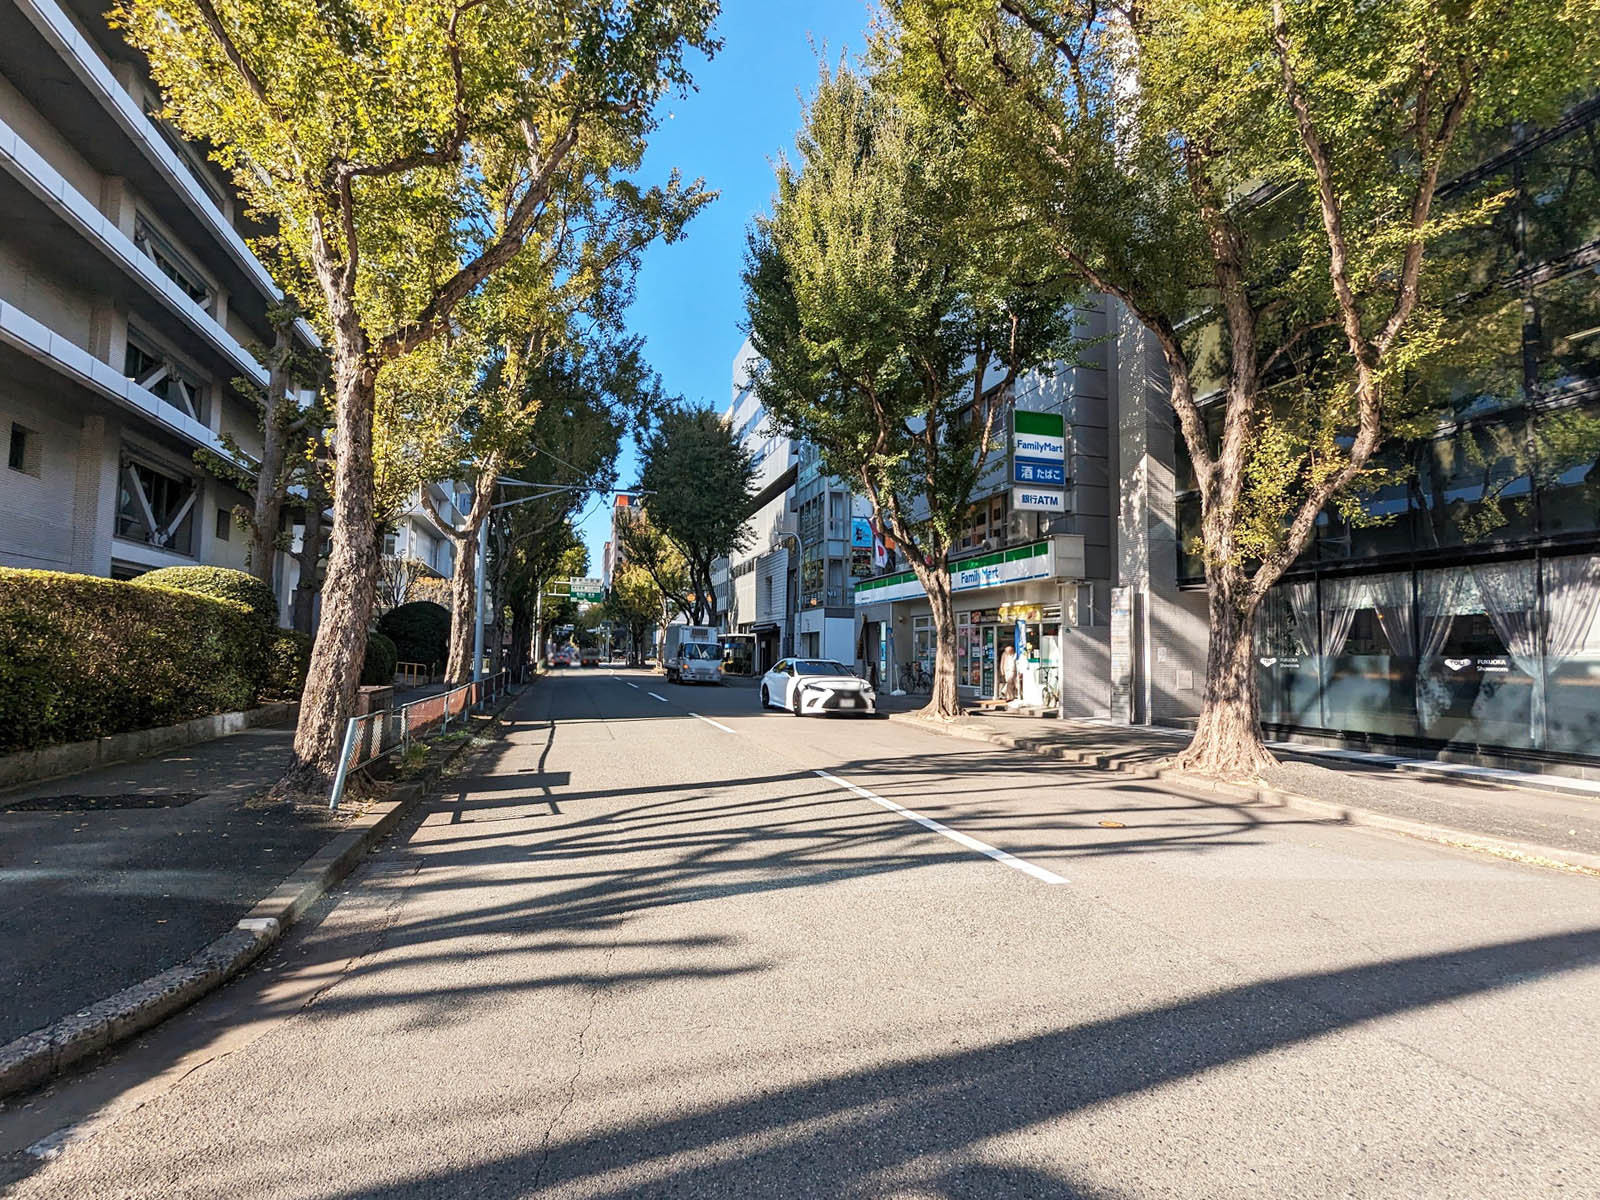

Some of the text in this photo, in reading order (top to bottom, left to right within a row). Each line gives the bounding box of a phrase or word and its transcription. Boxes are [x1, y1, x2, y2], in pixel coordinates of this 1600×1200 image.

[1017, 440, 1063, 453] FamilyMart
[1021, 466, 1060, 480] 酒 たばこ
[1021, 494, 1059, 505] 銀行ATM
